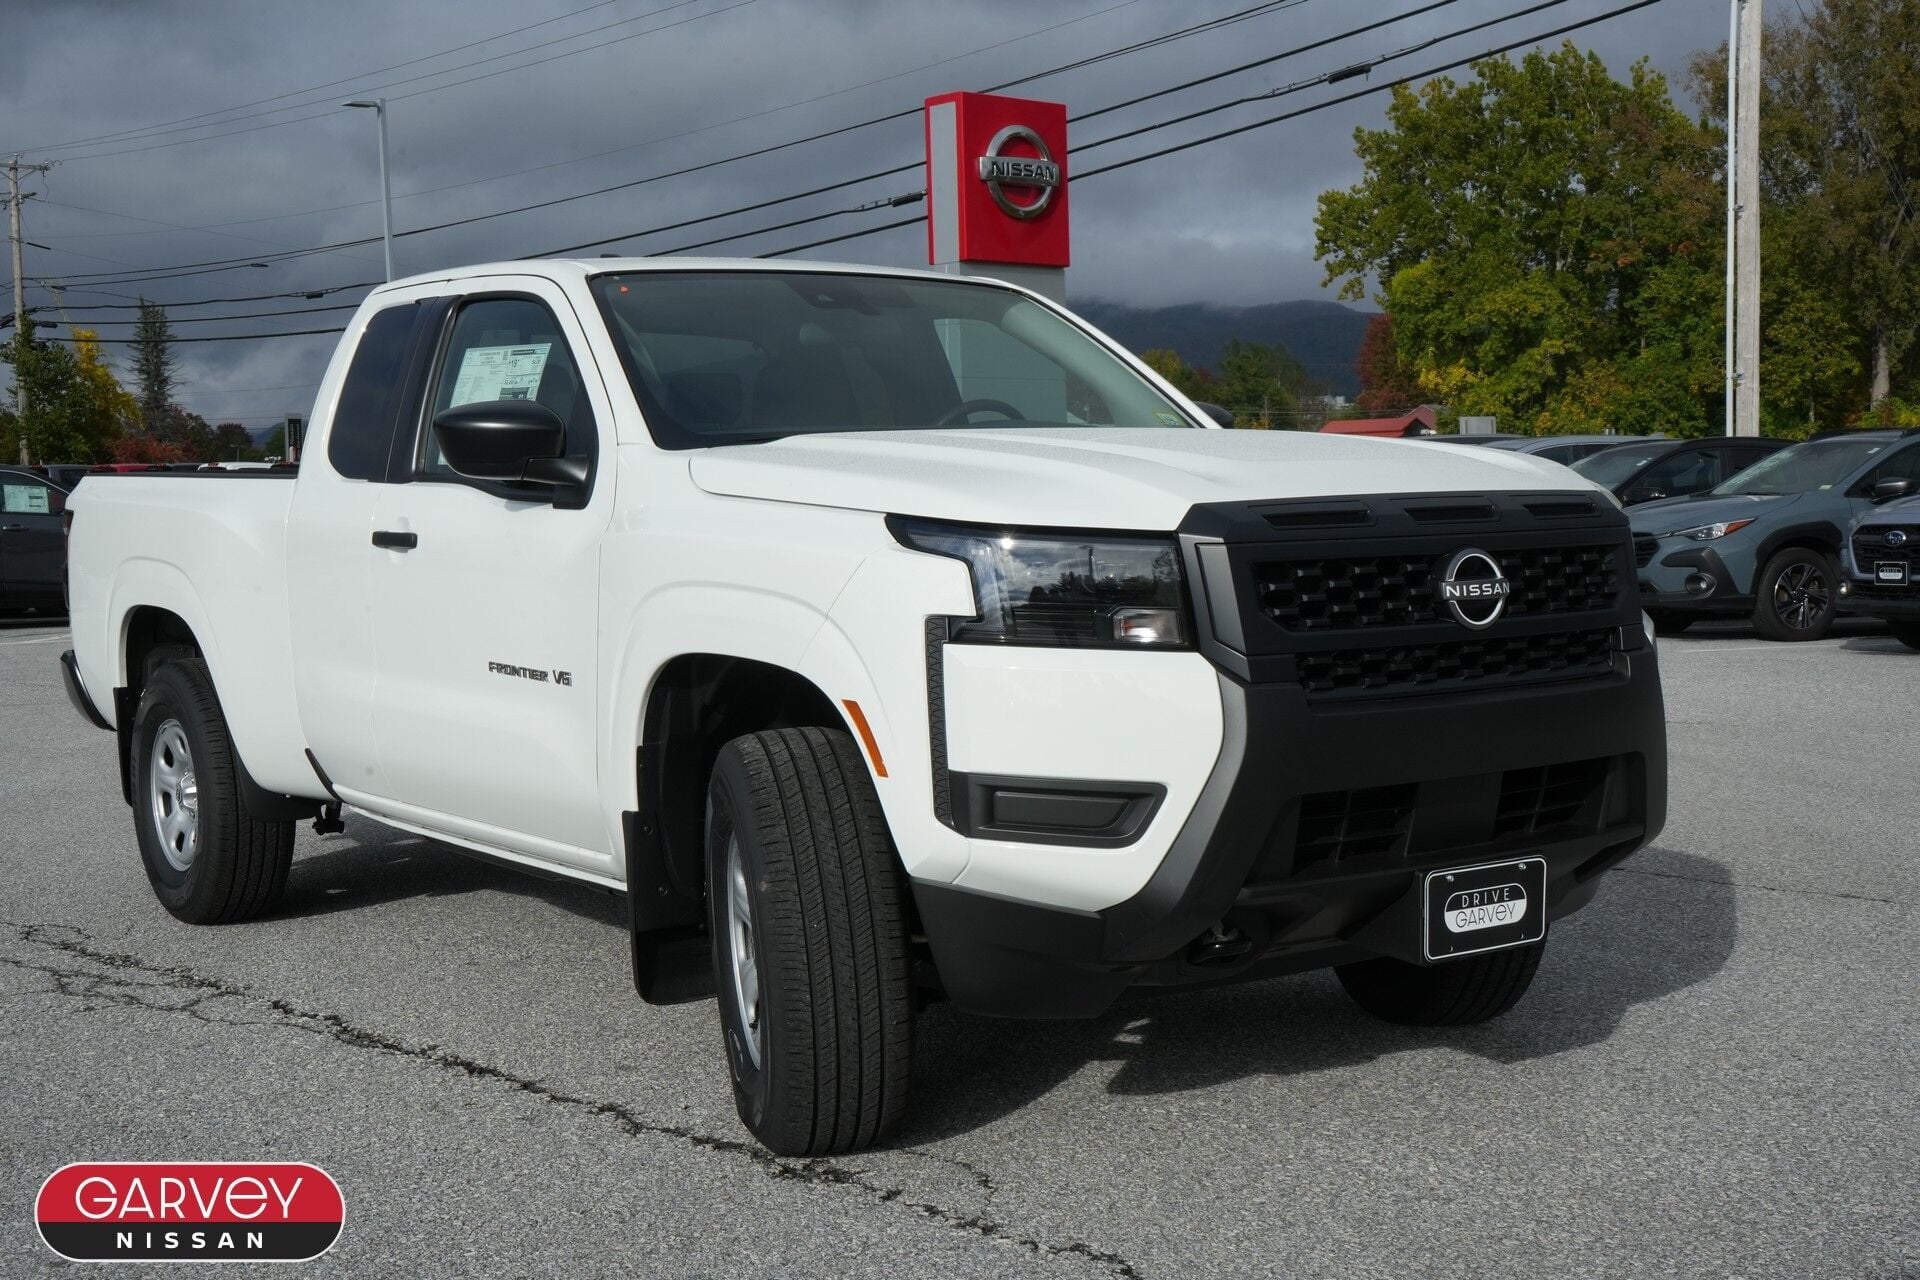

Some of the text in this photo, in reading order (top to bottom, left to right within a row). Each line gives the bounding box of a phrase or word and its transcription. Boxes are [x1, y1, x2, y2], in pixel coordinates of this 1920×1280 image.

[991, 160, 1056, 182] NISSAN
[1446, 582, 1510, 597] NISSAN
[488, 661, 572, 687] FRONTIER V6
[1461, 888, 1510, 908] DRIVE
[1455, 902, 1517, 928] GARVEY
